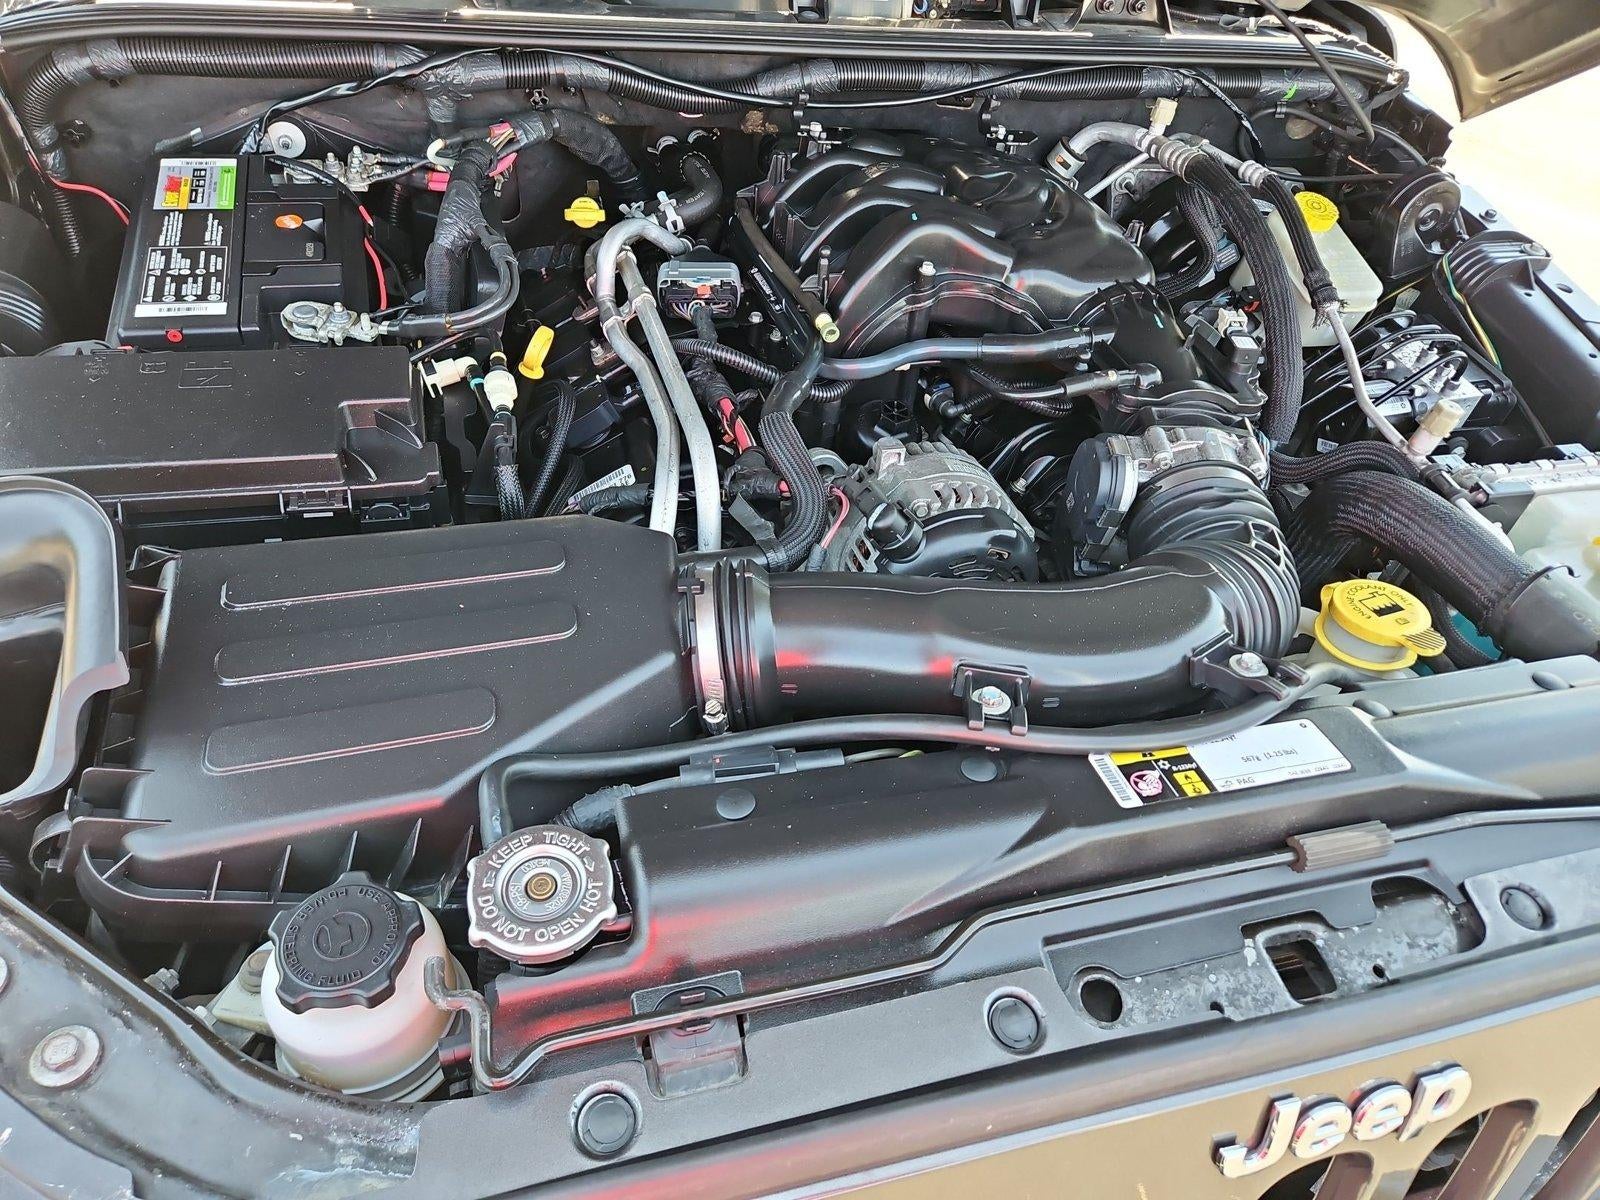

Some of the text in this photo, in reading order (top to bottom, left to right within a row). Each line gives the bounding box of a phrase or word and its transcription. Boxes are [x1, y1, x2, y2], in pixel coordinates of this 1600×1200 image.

[1346, 596, 1372, 619] ENGINE
[1347, 584, 1387, 596] COOLANT
[1236, 777, 1256, 786] PAG
[488, 831, 591, 869] KEEP TIGHT
[357, 887, 399, 966] USE APPROVED
[477, 878, 604, 942] DO NOT OPEN HOT
[284, 888, 363, 986] POWER STEERING FLUID
[1211, 1061, 1472, 1178] Jeep
